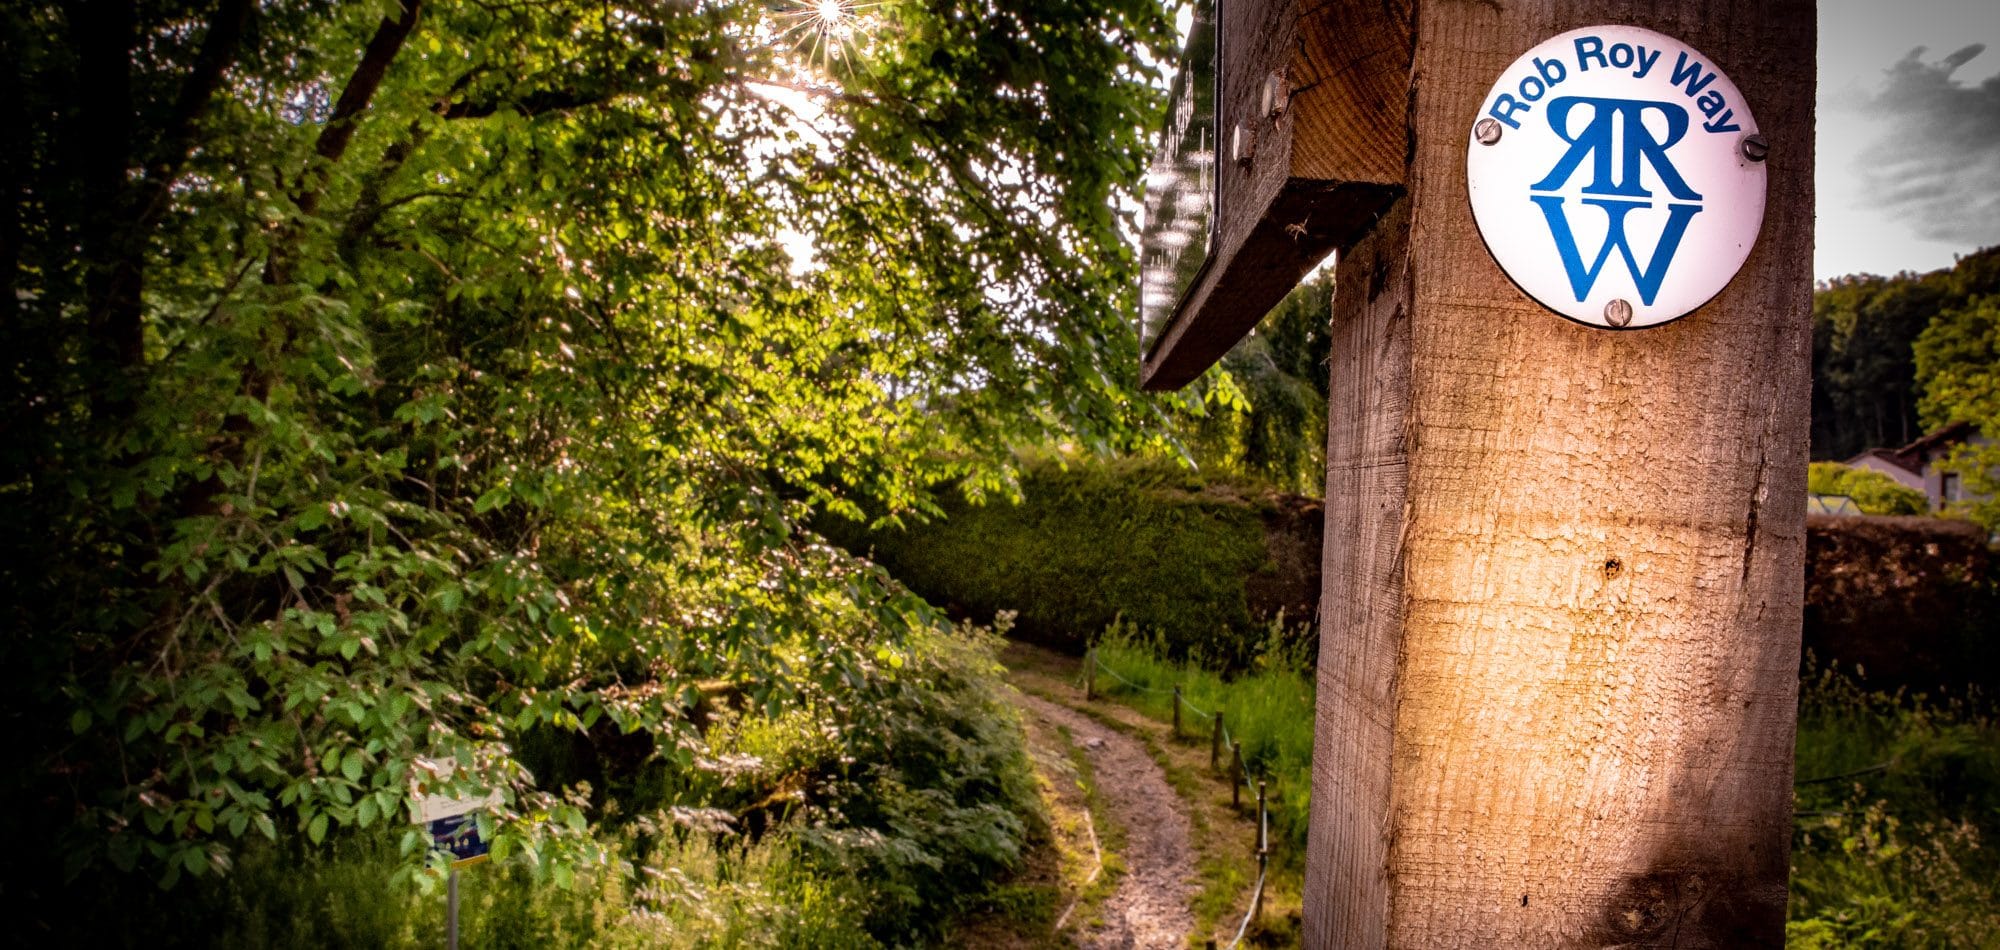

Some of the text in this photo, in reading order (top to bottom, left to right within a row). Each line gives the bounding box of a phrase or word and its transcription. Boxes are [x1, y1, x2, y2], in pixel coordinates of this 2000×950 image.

[1489, 35, 1741, 136] Rob Roy Way
